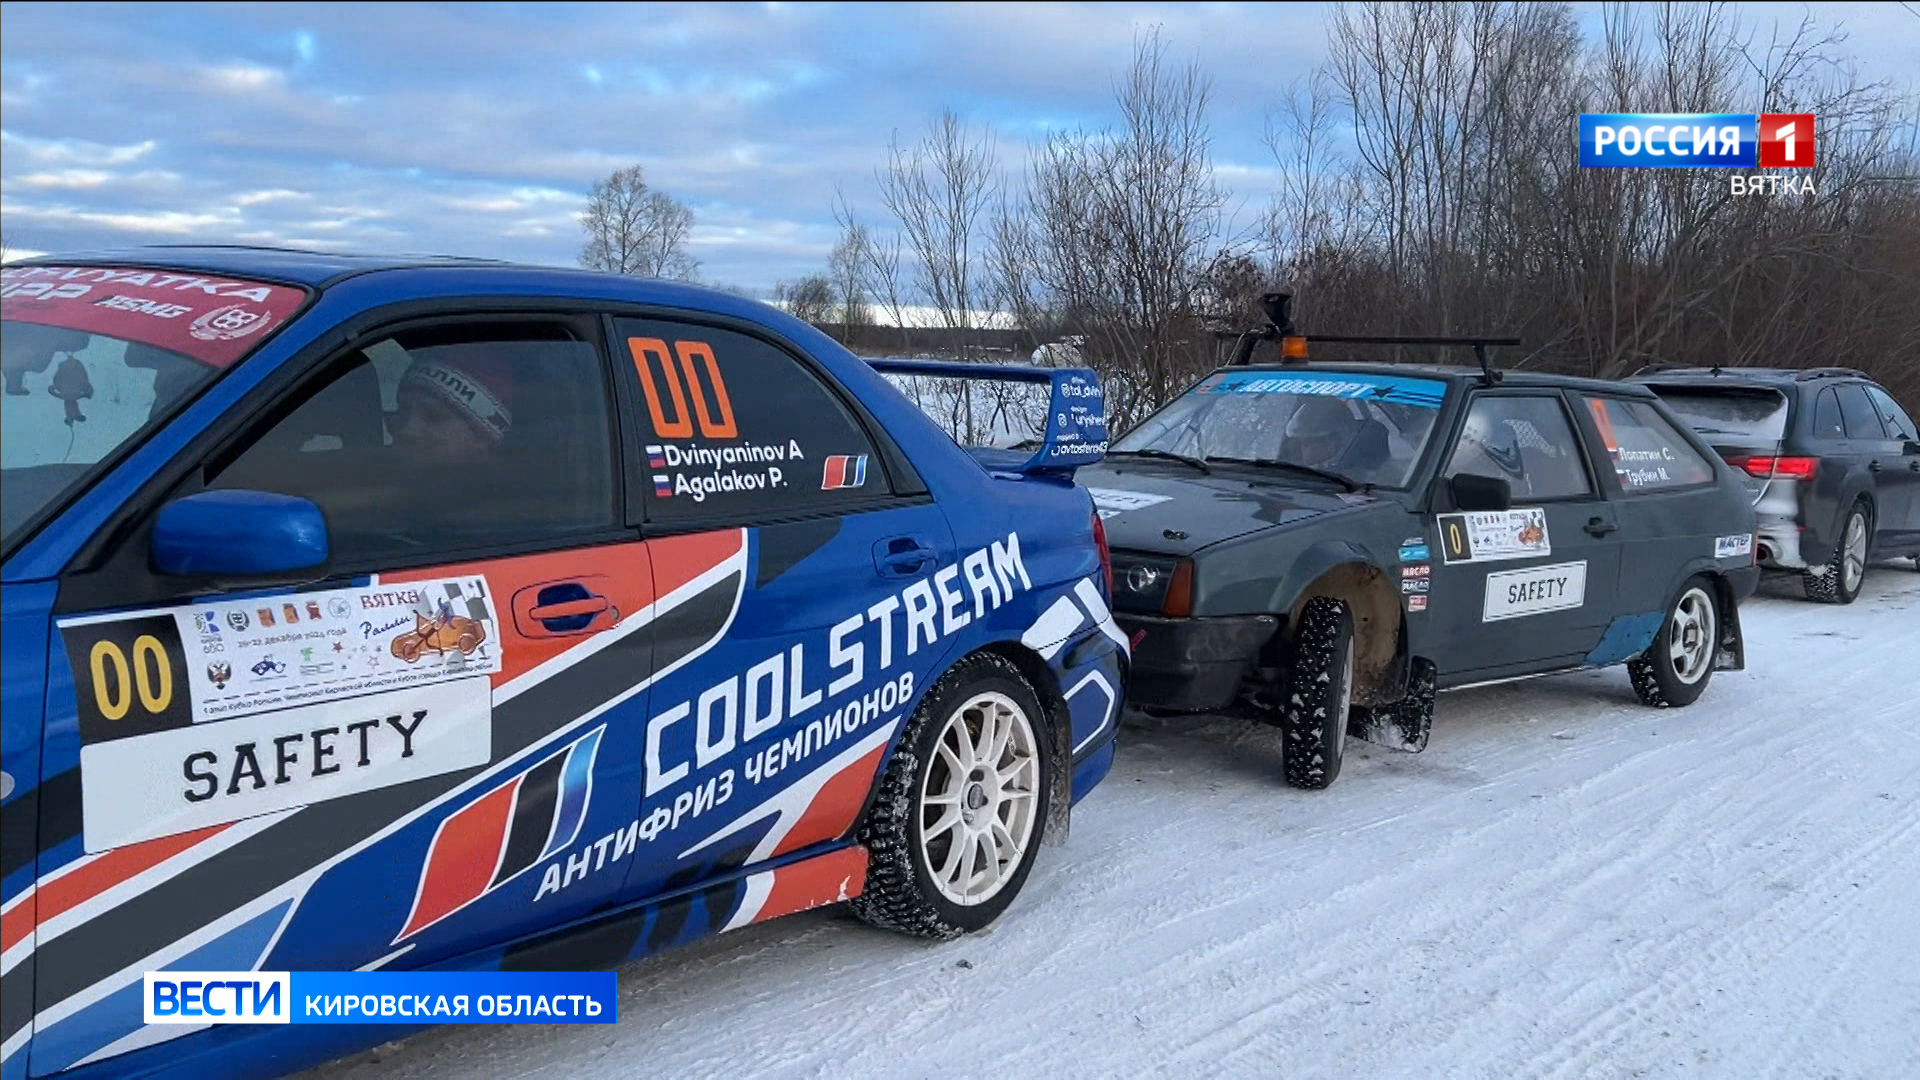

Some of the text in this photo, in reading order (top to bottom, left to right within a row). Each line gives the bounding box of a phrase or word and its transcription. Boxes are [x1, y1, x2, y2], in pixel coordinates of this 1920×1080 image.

[627, 337, 738, 438] 00
[664, 439, 804, 470] Dvinyaninov A
[675, 467, 788, 502] Agalakov P.
[1450, 523, 1461, 554] 0
[1508, 577, 1568, 604] SAFETY
[89, 634, 173, 721] 00
[645, 531, 1032, 797] COOLSTREAM
[182, 709, 428, 803] SAFETY
[533, 671, 915, 902] АНТИФРИЗ ЧЕМПИОНОВ
